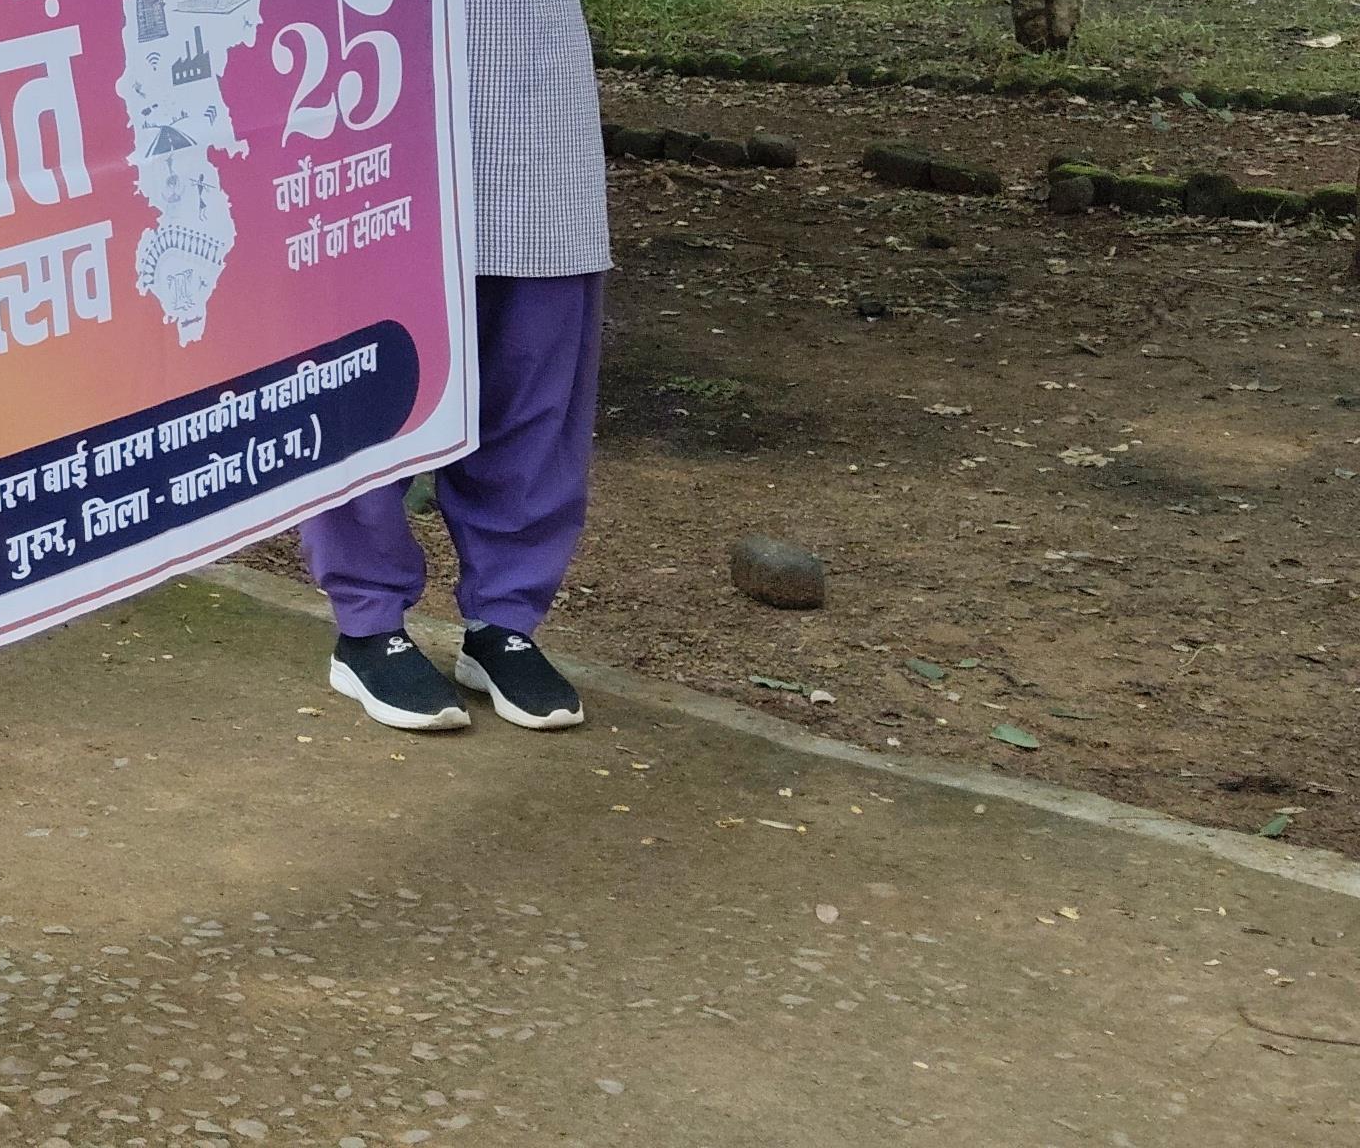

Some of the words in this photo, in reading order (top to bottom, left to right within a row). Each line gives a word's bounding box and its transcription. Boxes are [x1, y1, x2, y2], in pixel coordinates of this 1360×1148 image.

[313, 159, 342, 200] का
[343, 143, 392, 193] उत्सव
[323, 217, 350, 259] का
[352, 195, 412, 249] संकल्प
[41, 439, 89, 494] बाई
[92, 427, 155, 477] तारम
[158, 390, 257, 453] शासकीय
[260, 342, 379, 413] महाविद्यालय
[82, 488, 150, 543] जिला
[169, 452, 244, 506] बालोद
